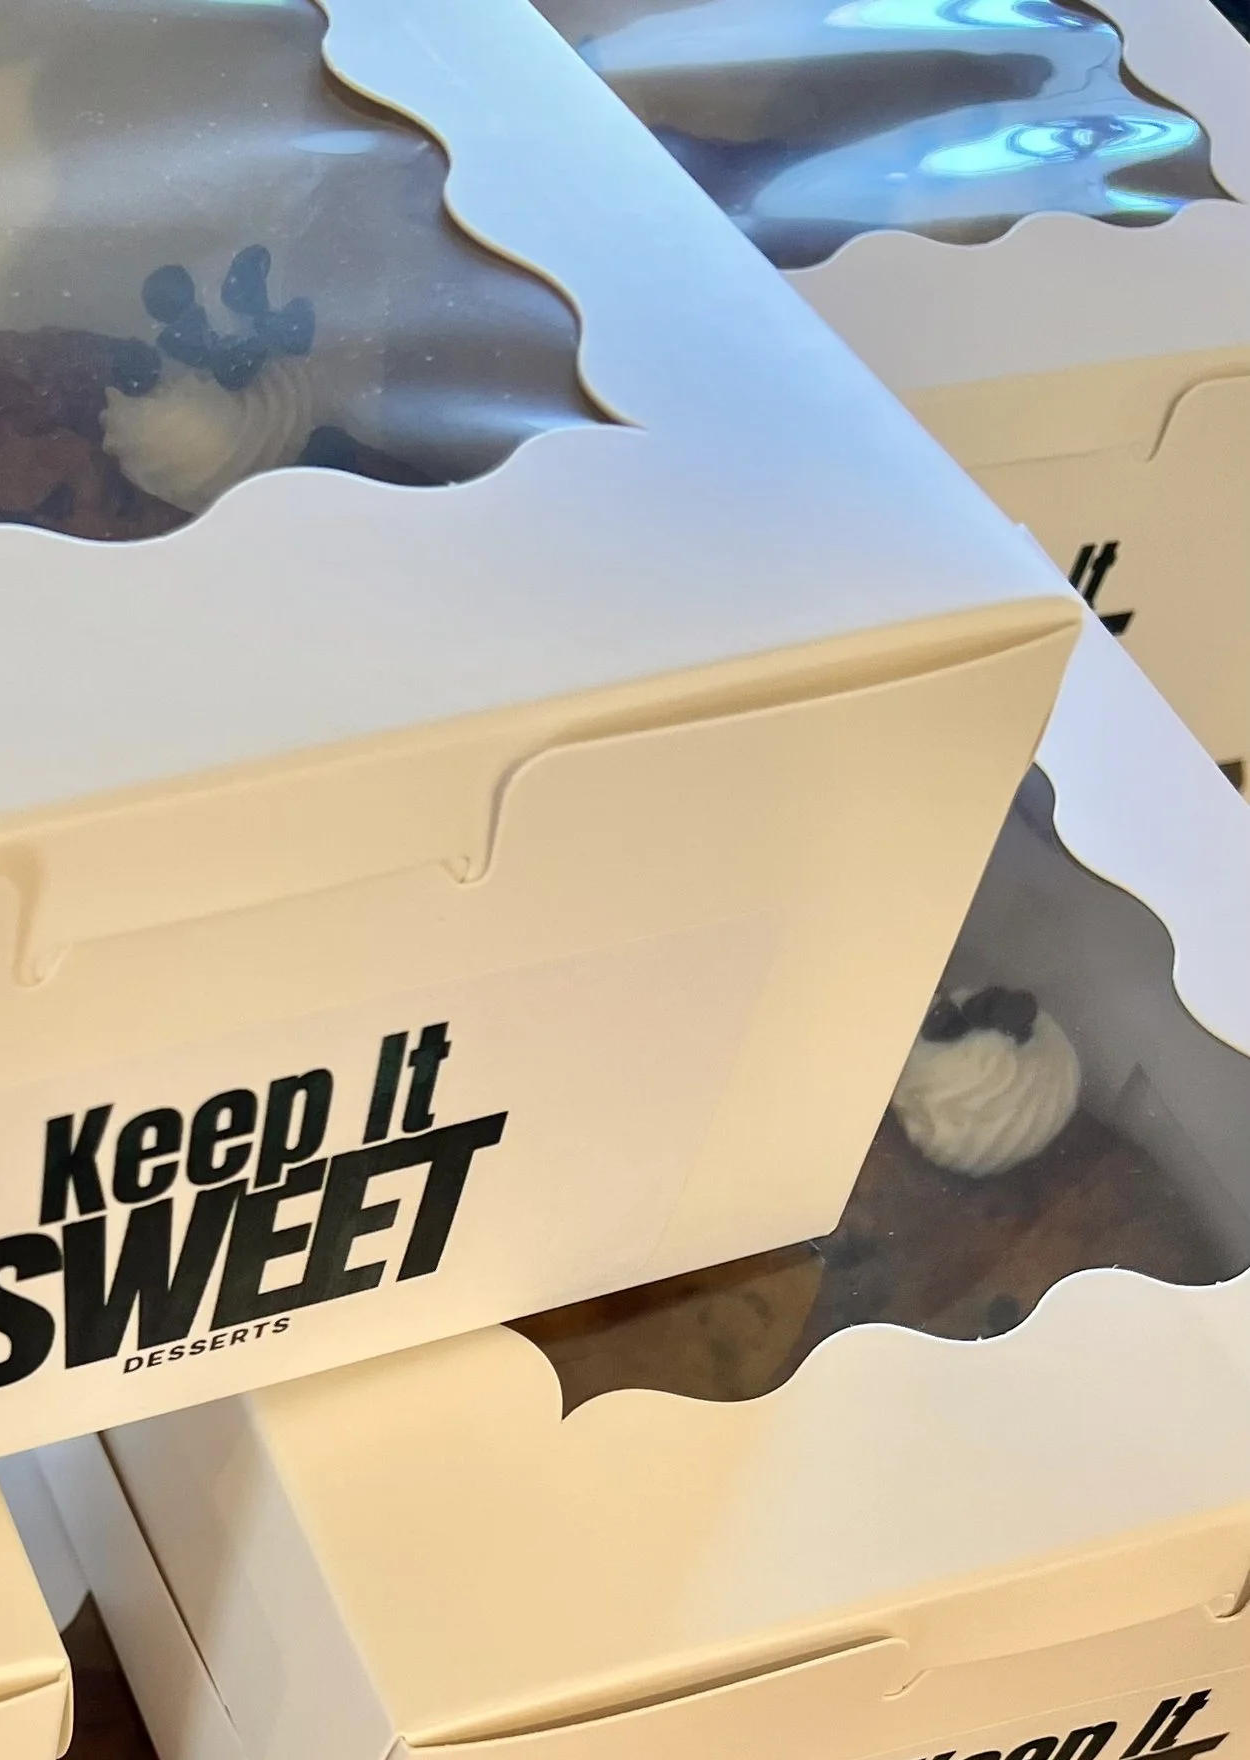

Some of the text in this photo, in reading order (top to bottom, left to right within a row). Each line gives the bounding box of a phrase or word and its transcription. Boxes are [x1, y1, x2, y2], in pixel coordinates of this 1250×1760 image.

[38, 1021, 452, 1225] Keep It
[123, 1317, 290, 1374] DESSERTS
[1118, 1688, 1212, 1760] It
